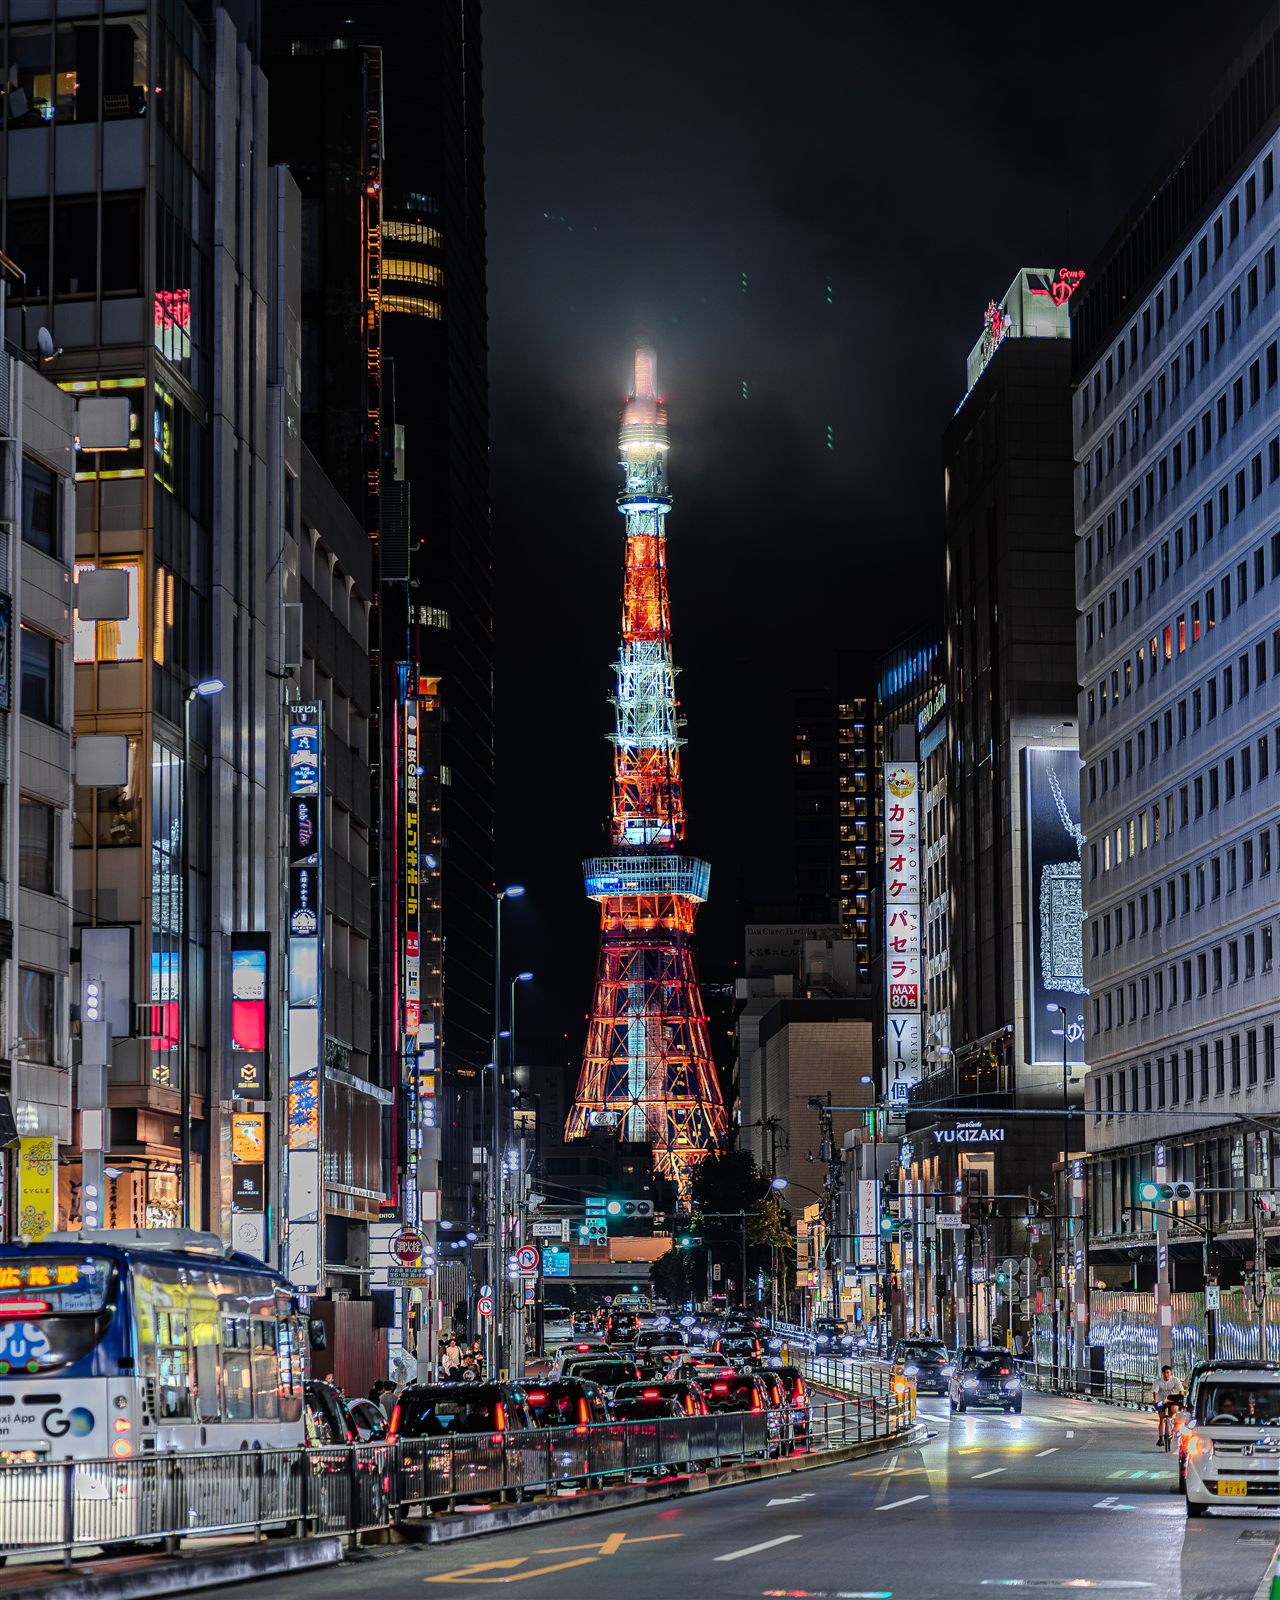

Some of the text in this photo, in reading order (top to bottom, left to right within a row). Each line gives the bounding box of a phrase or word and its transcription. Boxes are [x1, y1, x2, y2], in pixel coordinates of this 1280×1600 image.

[888, 804, 908, 897] カラオケ
[908, 807, 917, 892] KARAOKE
[888, 910, 908, 979] パセラ
[910, 914, 918, 975] PASELA
[892, 985, 915, 995] MAX
[892, 995, 916, 1008] 80名
[934, 1129, 1004, 1143] YUKIZAKI
[396, 1241, 421, 1253] 消火栓
[13, 1414, 36, 1424] App
